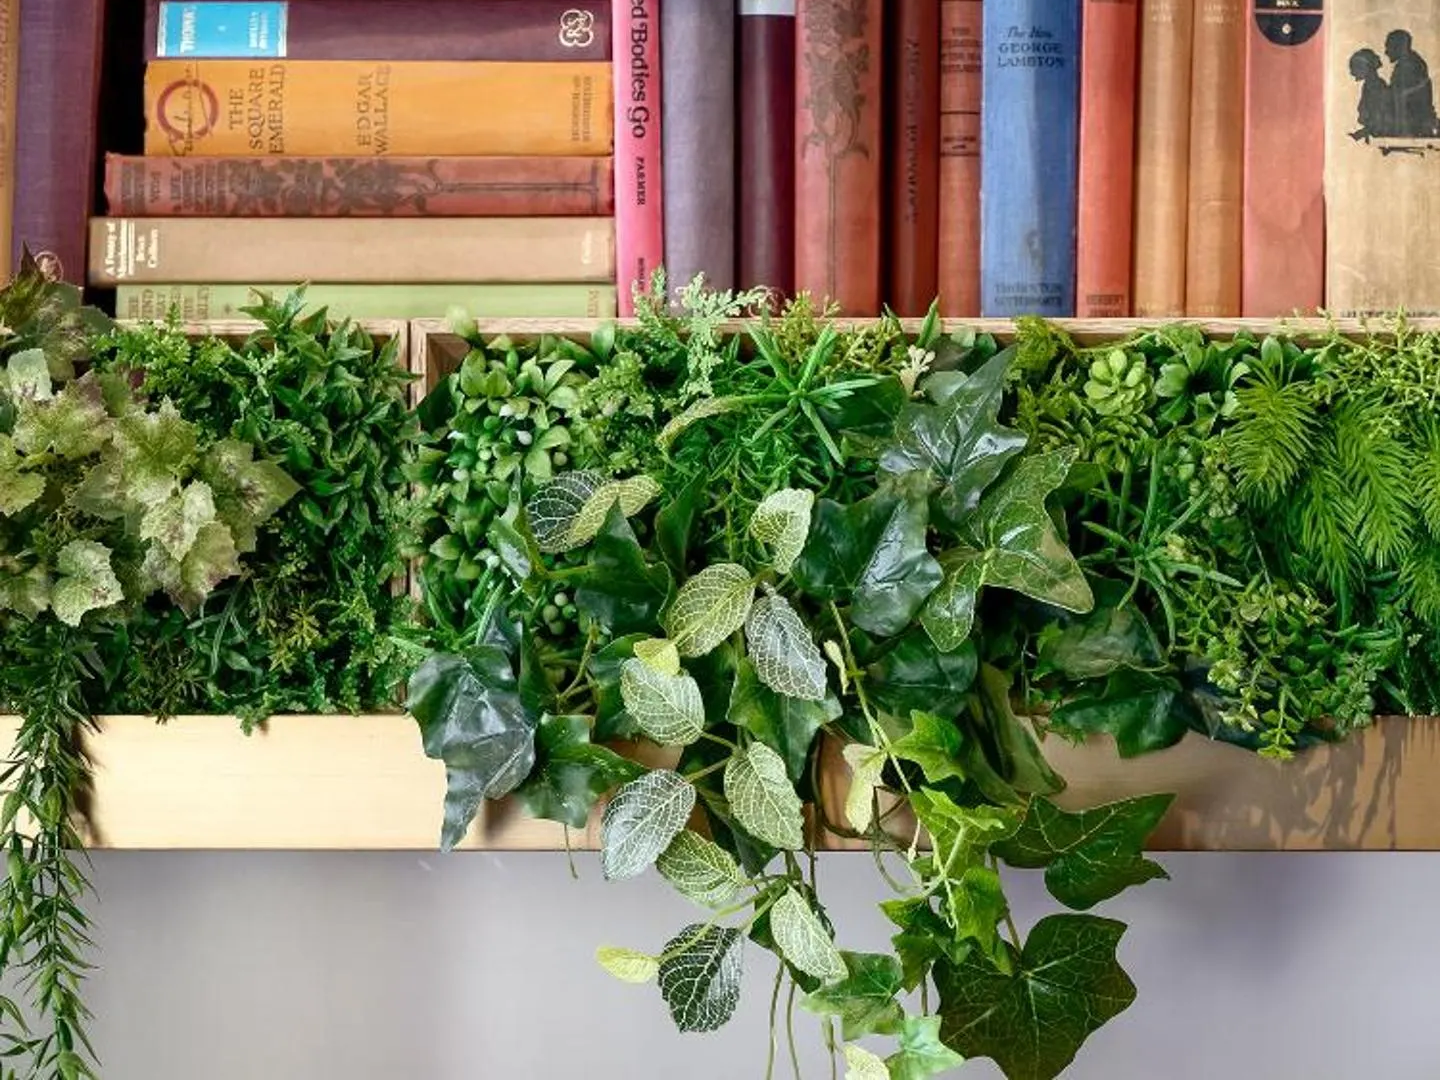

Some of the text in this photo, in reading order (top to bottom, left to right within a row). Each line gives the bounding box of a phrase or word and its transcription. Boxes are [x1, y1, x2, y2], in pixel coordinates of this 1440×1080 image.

[630, 23, 650, 101] Bodies
[997, 56, 1065, 68] LAMBTON
[998, 42, 1063, 55] GEORGE
[228, 87, 244, 131] THE
[248, 67, 265, 150] SQUARE
[268, 64, 286, 155] EMERALD
[356, 71, 373, 148] EDGAR
[375, 65, 391, 156] WALLACE
[627, 105, 651, 139] Go
[636, 156, 647, 206] FARMER
